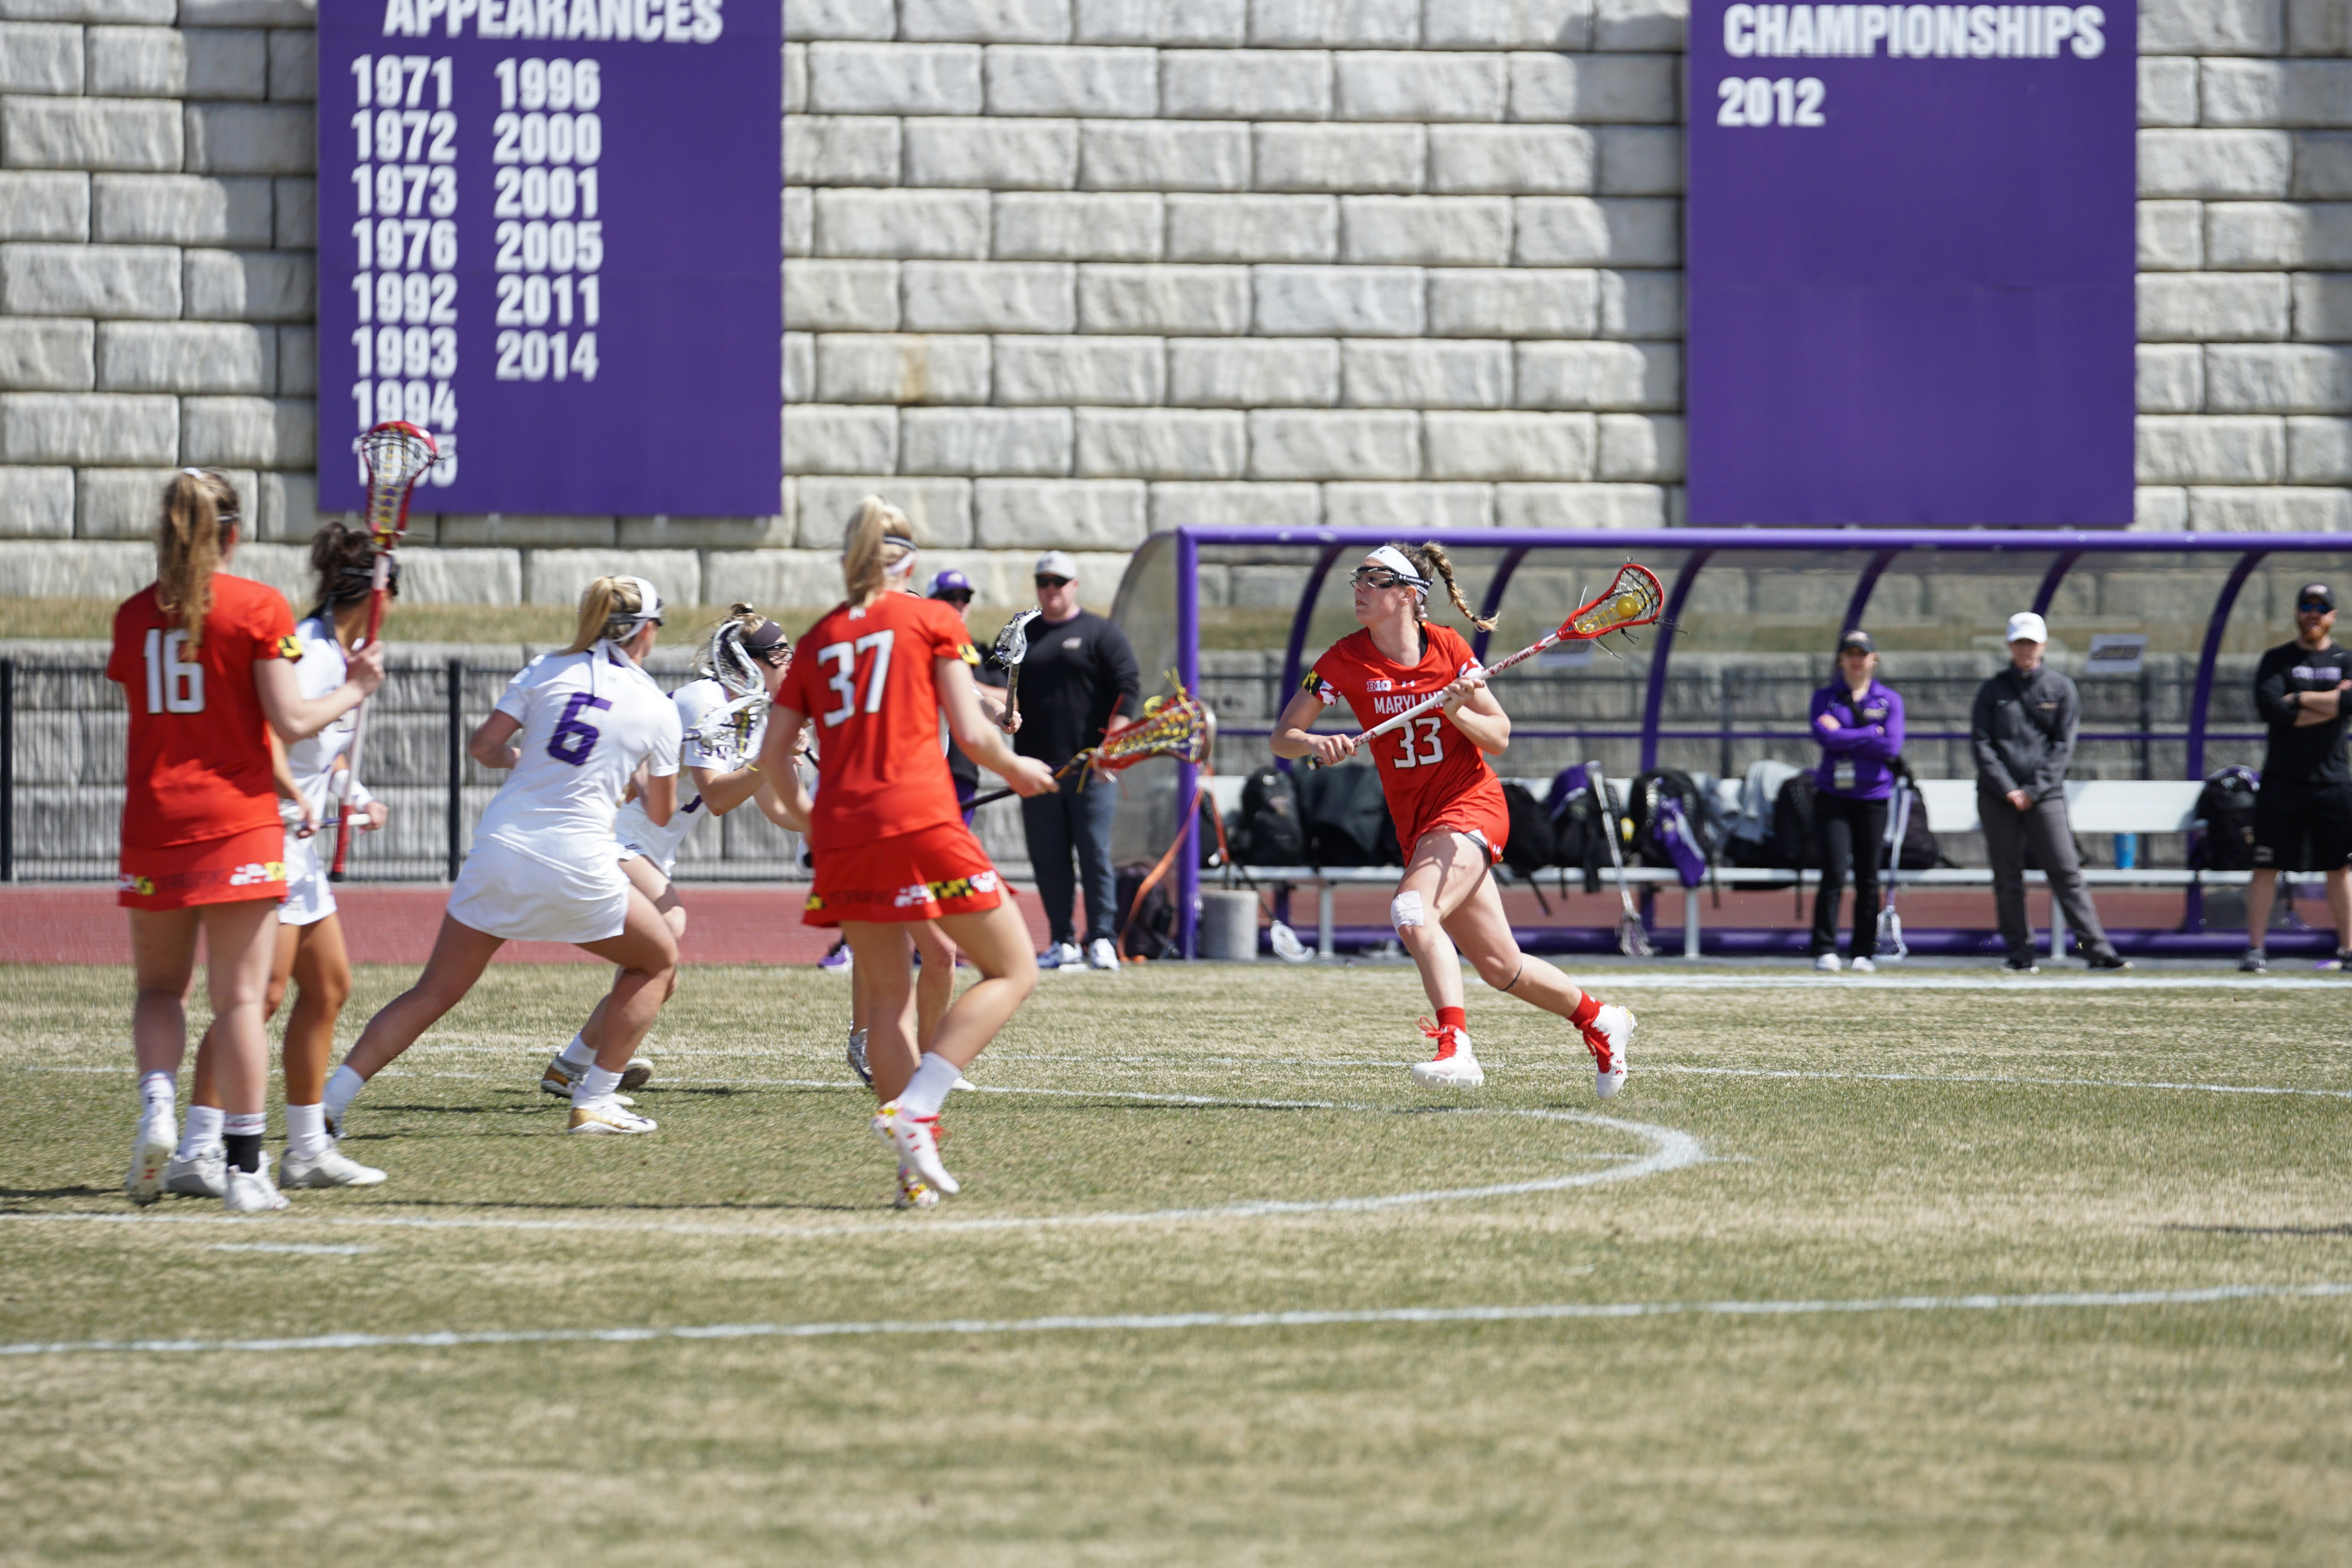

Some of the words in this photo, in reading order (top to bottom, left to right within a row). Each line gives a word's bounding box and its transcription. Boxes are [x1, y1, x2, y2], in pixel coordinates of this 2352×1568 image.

[384, 0, 722, 42] APPEARANCES
[1724, 4, 2104, 58] CHAMPIONSHIPS
[352, 55, 452, 108] 1971
[495, 58, 600, 110] 1996
[1717, 77, 1824, 126] 2012
[352, 109, 457, 162] 1972
[494, 113, 601, 164] 2000
[352, 164, 457, 216] 1973
[495, 166, 597, 218] 2001
[353, 218, 457, 270] 1976
[496, 221, 603, 272] 2005
[353, 272, 457, 324] 1992
[497, 274, 599, 325] 2011
[352, 326, 457, 378] 1993
[497, 330, 598, 380] 2014
[352, 379, 457, 432] 1994
[143, 628, 205, 714] 16
[817, 630, 894, 728] 37
[546, 691, 613, 767] 6
[1390, 717, 1444, 769] 33
